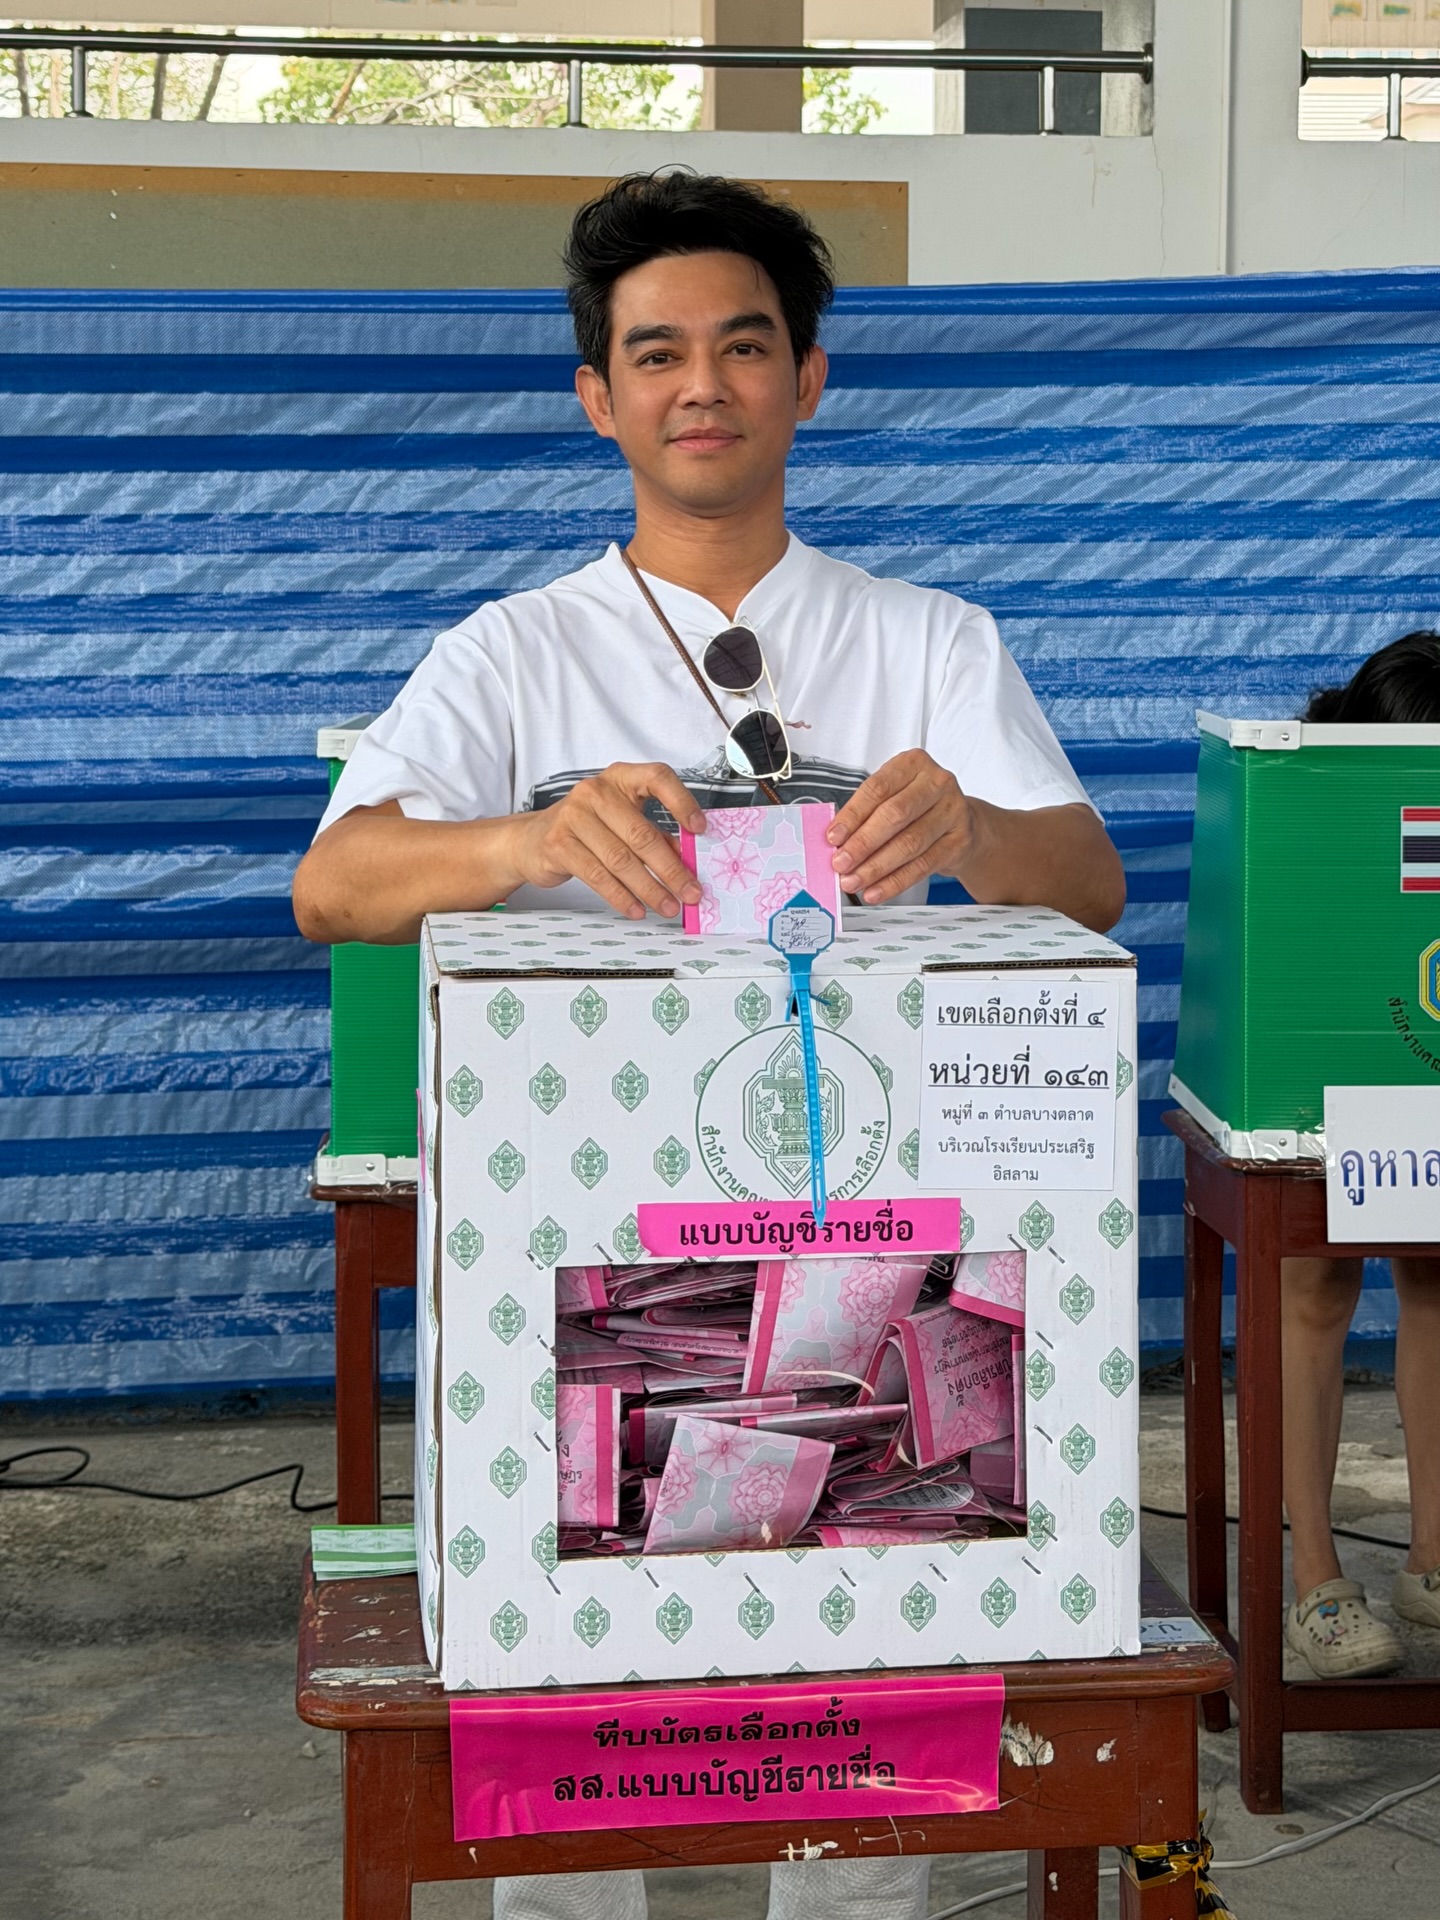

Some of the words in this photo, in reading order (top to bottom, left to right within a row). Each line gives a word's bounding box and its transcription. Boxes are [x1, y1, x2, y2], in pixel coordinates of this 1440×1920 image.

[937, 990, 1078, 1025] เขตเลือกตั้งที่
[1087, 1008, 1107, 1026] ๔
[928, 1045, 1031, 1086] หน่วยที่
[1044, 1063, 1109, 1087] ๑๔๓
[941, 1100, 973, 1126] หมู่ที่
[977, 1110, 989, 1121] ๓
[994, 1104, 1094, 1122] ตำบลบางตลาด
[938, 1136, 1096, 1160] บริเวณโรงเรียนประเสริฐ
[993, 1165, 1040, 1182] อิสลาม
[593, 1696, 861, 1748] หีบบัตรเลือกตั้ง
[552, 1744, 897, 1802] สส.แบบบัญชีรายชื่อ
